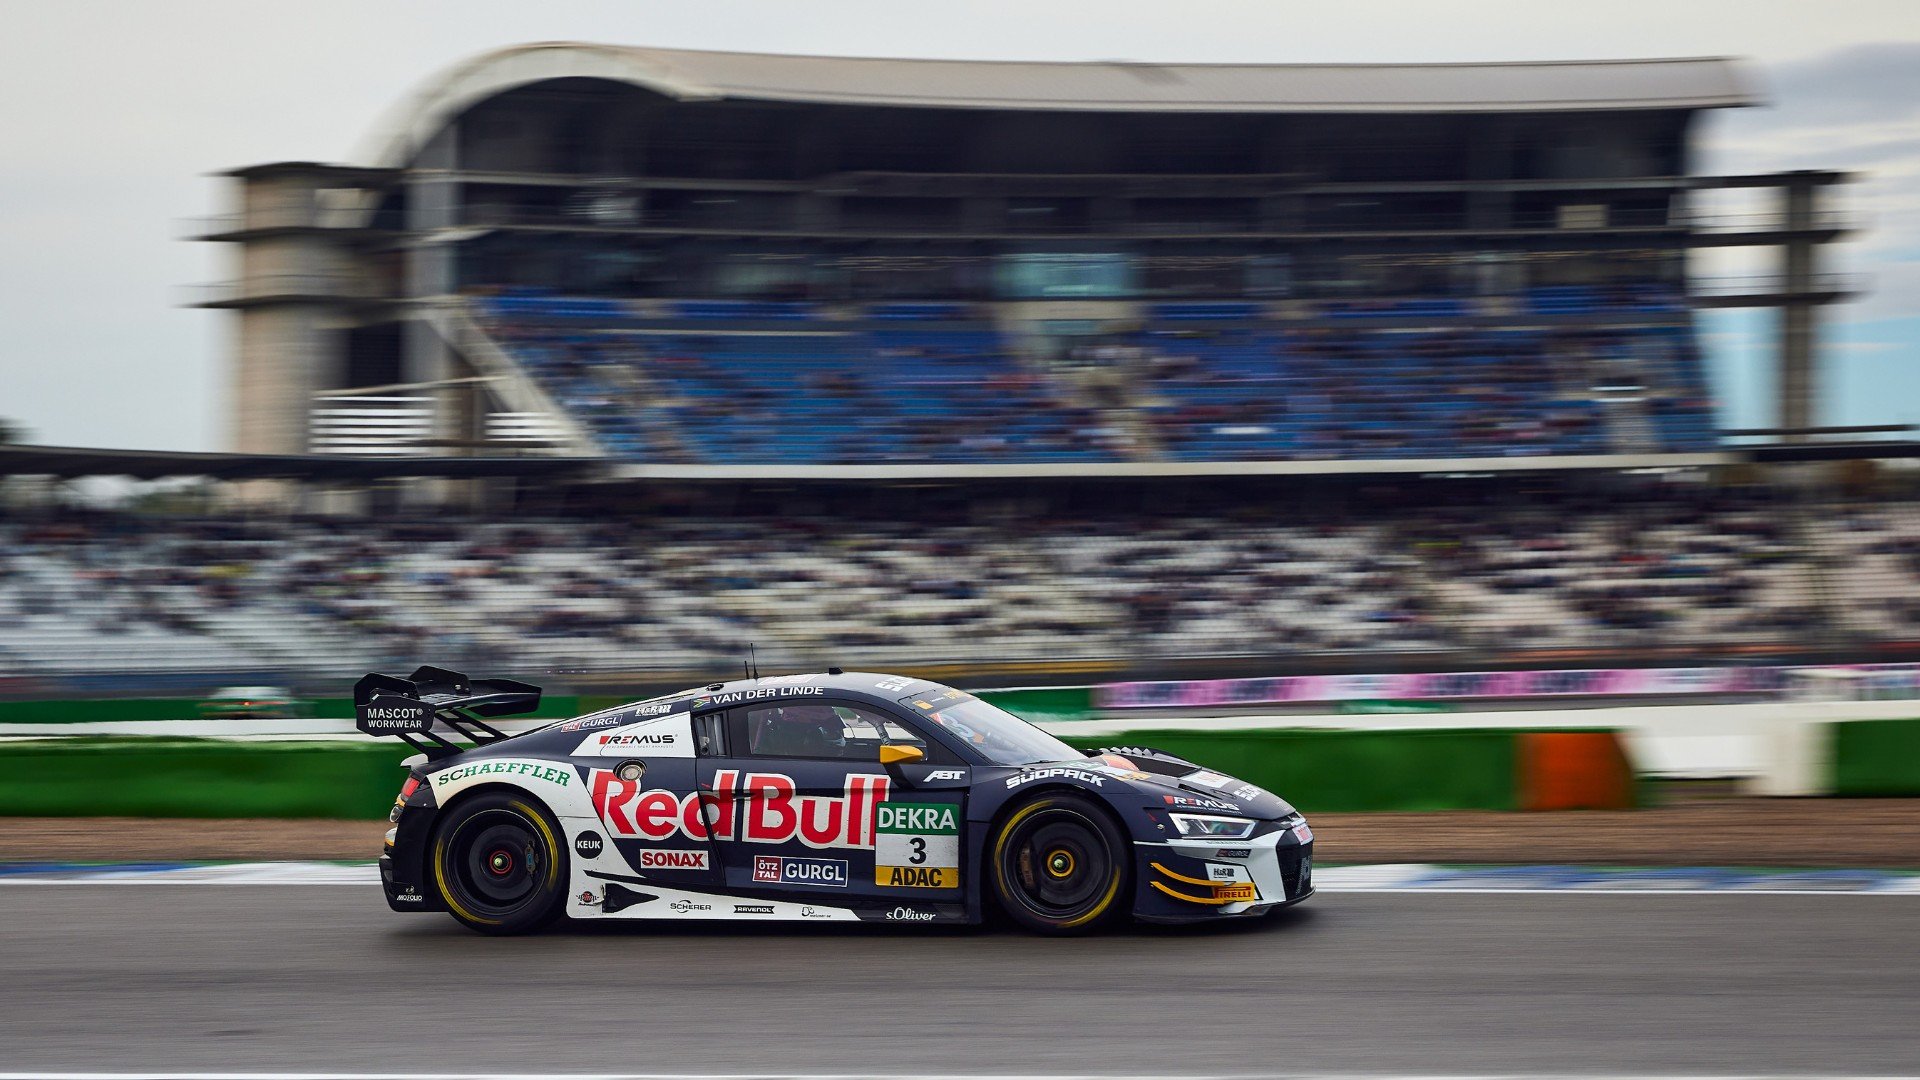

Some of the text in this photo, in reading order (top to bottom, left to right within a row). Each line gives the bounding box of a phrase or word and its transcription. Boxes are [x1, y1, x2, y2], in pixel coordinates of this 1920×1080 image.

[713, 686, 825, 704] VAN DER LINDE
[367, 720, 422, 728] WORKWEAR
[582, 716, 619, 728] GURGL
[607, 734, 674, 745] REMUS
[438, 762, 571, 787] SCHAEFFLER
[923, 768, 965, 782] ABT
[592, 771, 889, 847] Red Bull
[1173, 796, 1240, 811] REMUS
[878, 807, 957, 830] DEKRA
[577, 840, 601, 849] KEUK
[908, 837, 927, 865] 3
[641, 851, 705, 867] SONAX
[758, 870, 777, 879] TAL
[785, 863, 845, 880] GURGL
[890, 868, 942, 887] ADAC
[1214, 886, 1252, 898] PIRELLI
[670, 902, 712, 911] SCHERER
[885, 906, 937, 921] s.Oliver
